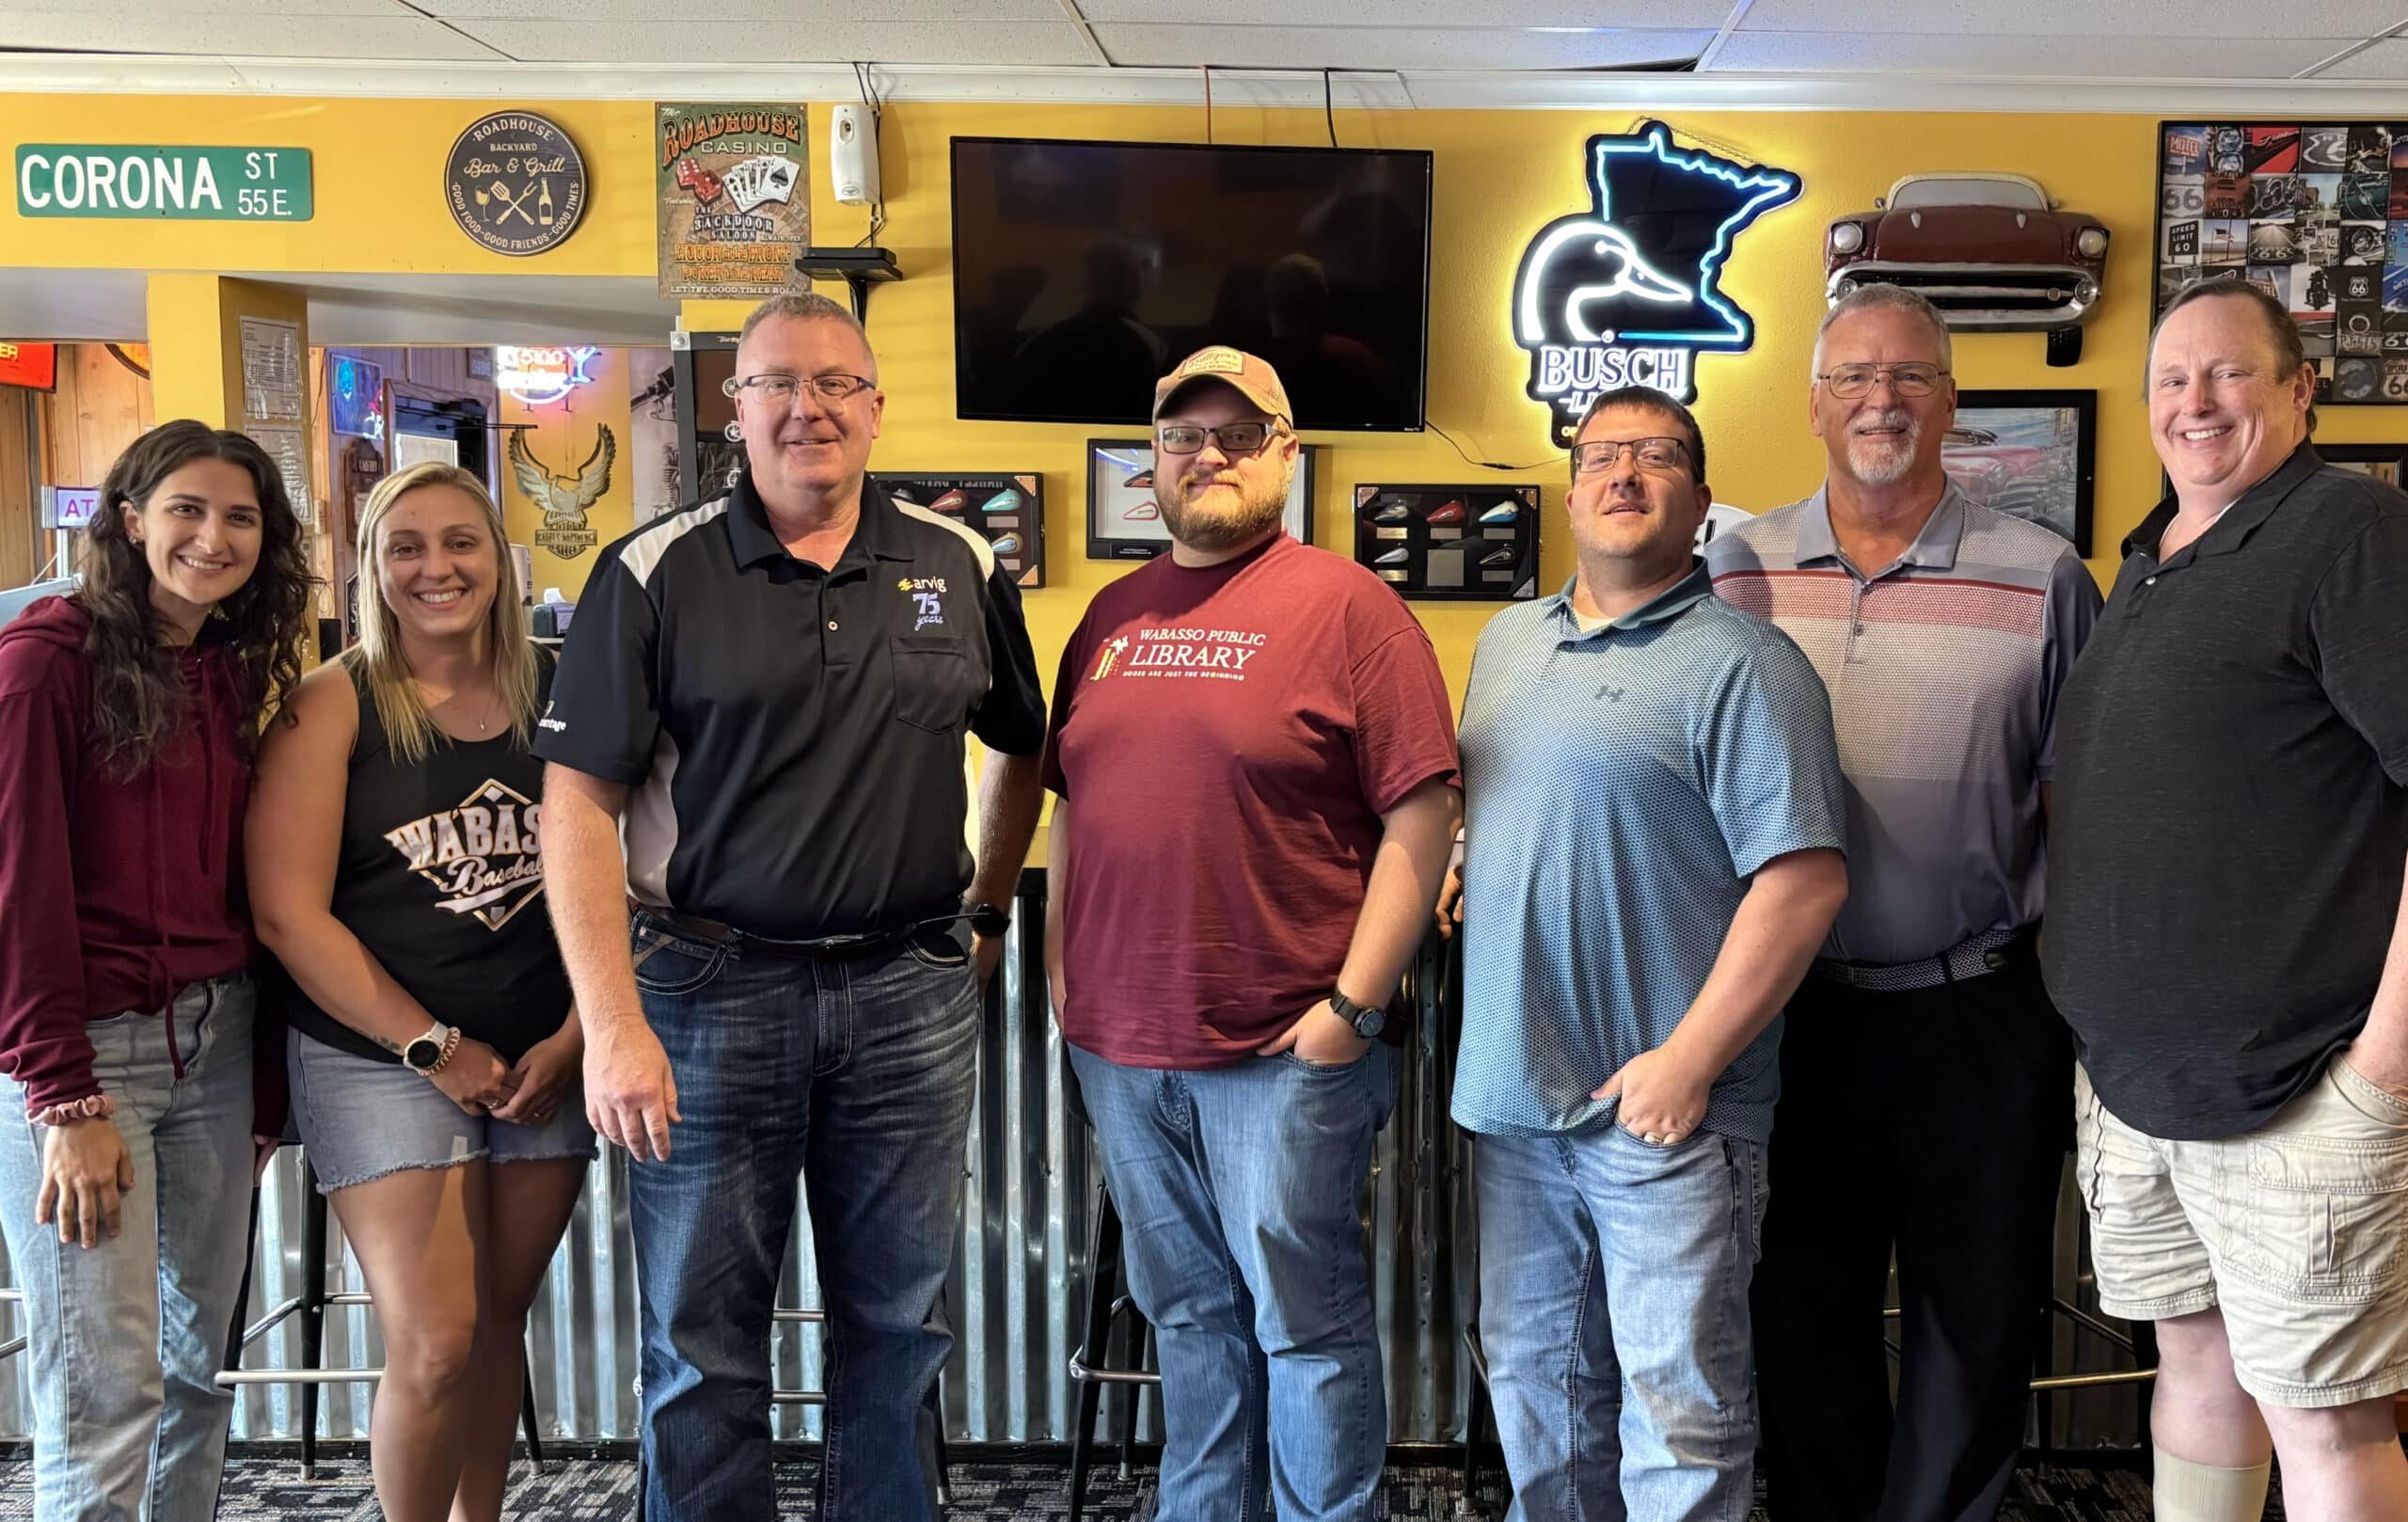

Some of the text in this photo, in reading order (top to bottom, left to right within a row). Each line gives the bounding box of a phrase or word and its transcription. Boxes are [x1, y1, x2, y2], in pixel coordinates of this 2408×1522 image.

[473, 119, 553, 142] ROADHOUSE
[662, 111, 800, 166] ROADHOUSE
[490, 143, 538, 151] BACKYARD
[701, 142, 787, 153] CASINO
[464, 157, 565, 178] Bar & Grill
[22, 152, 278, 210] CORONA ST
[2163, 188, 2203, 211] 66
[452, 182, 579, 249] GOOD FOOD GOOD FRIENDS GOOD TIMES
[694, 214, 773, 232] BACKDOOR
[710, 230, 756, 241] SALOON
[675, 244, 722, 263] LIQUOR
[2175, 243, 2190, 252] 60
[2352, 284, 2366, 293] 66
[1538, 346, 1688, 397] BUSCH
[65, 499, 94, 517] AT
[913, 576, 947, 593] arvig
[912, 593, 941, 615] 75
[1140, 628, 1266, 646] WABASSO PUBLIC
[1129, 644, 1257, 670] LIBRARY
[384, 804, 543, 872] WABAS
